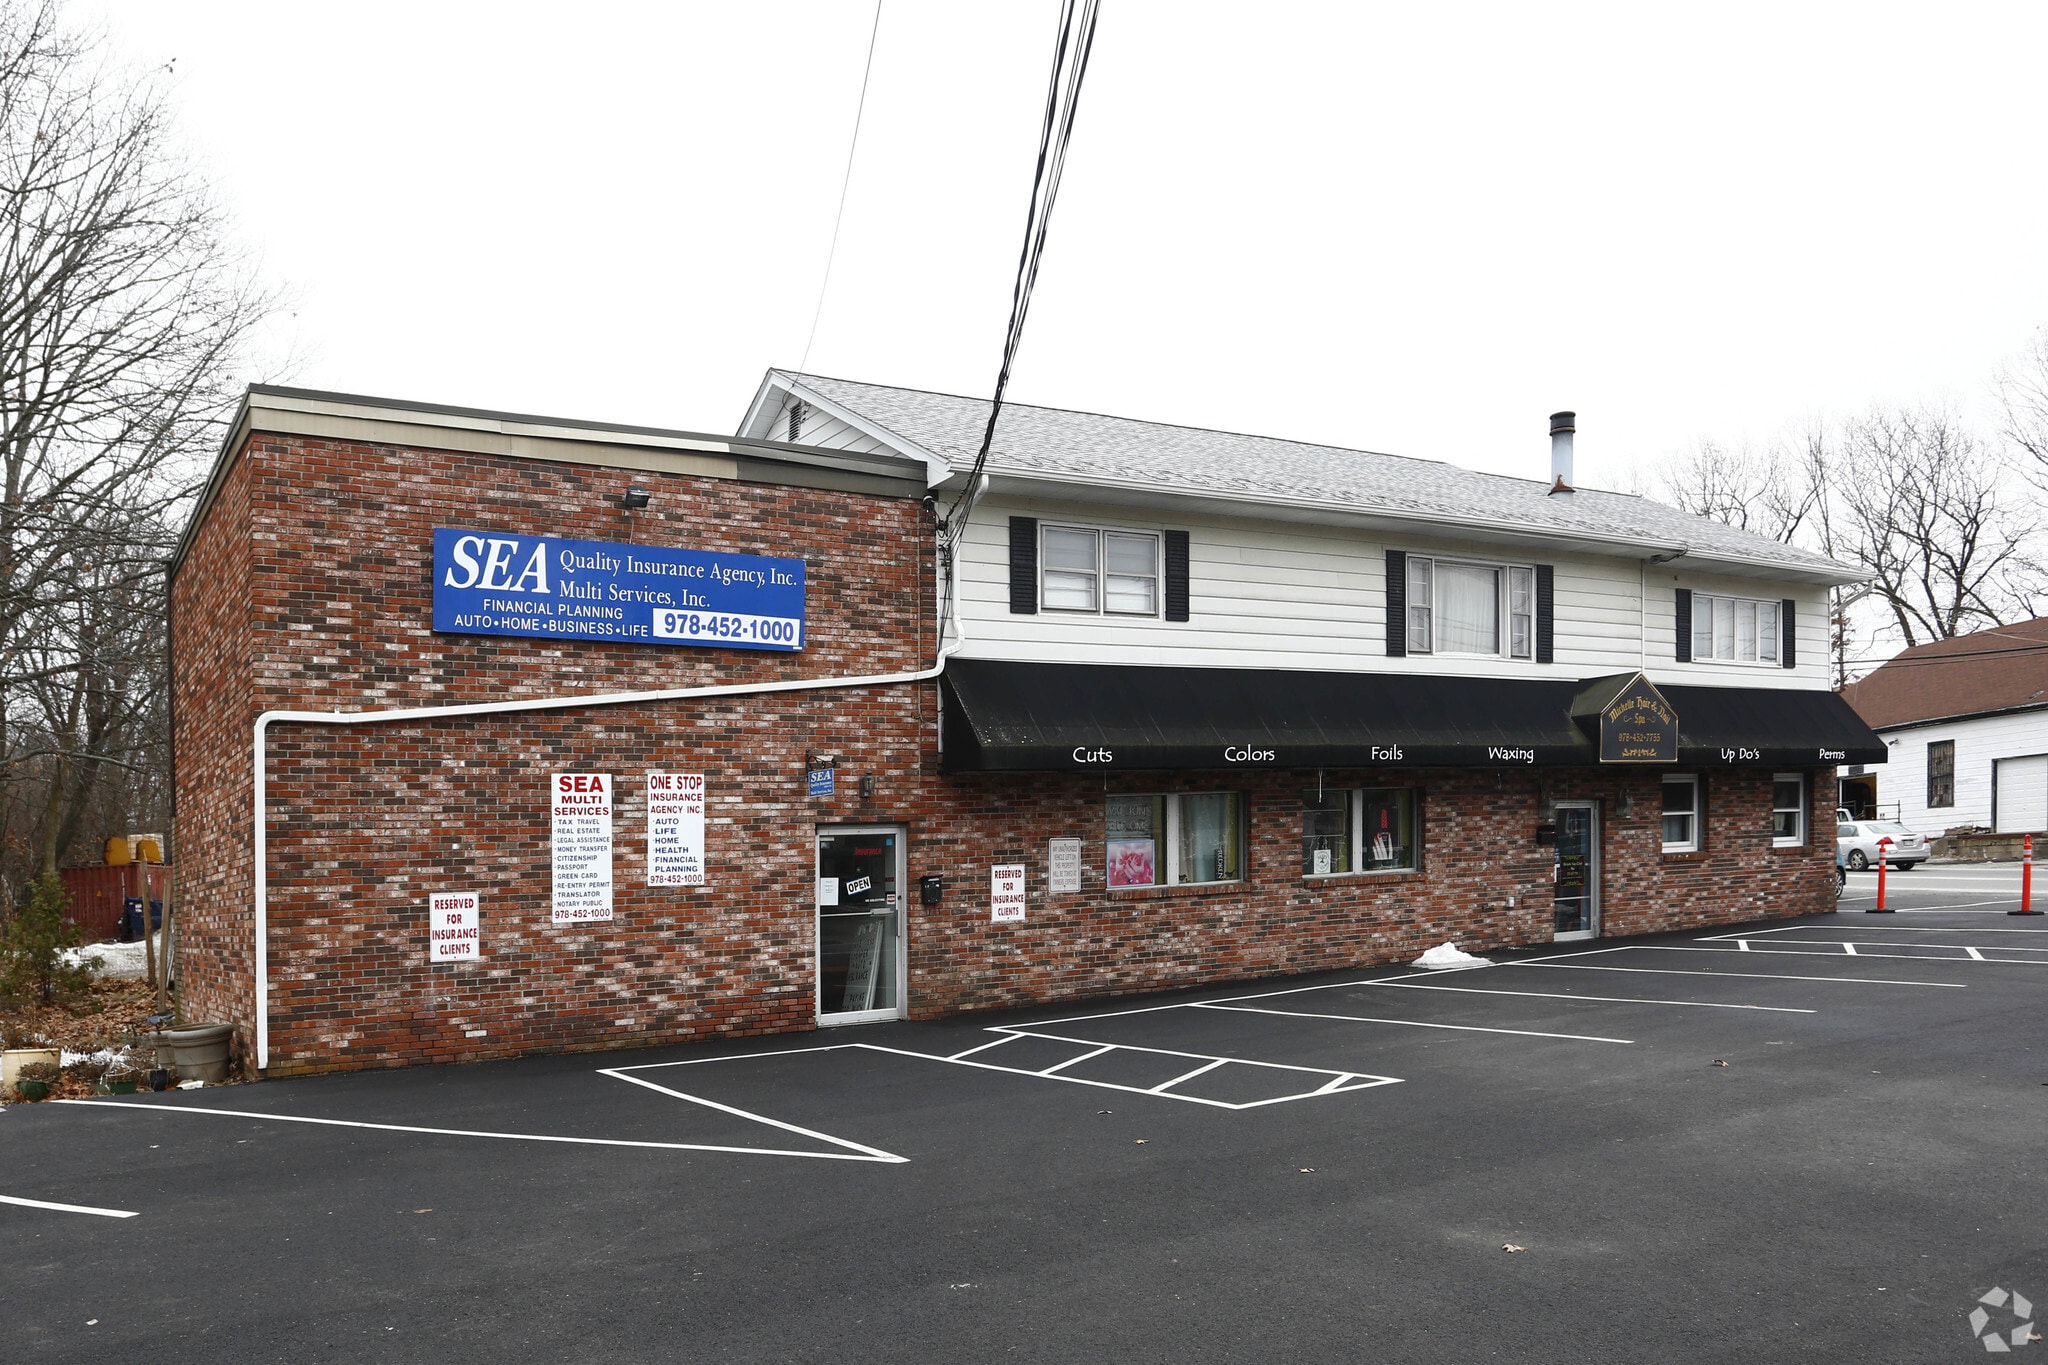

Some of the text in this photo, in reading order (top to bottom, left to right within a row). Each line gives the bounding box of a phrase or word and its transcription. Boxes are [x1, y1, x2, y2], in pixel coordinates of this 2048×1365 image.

[444, 536, 551, 594] SEA
[560, 549, 797, 588] Quality Insurance Agency, Inc.
[559, 580, 710, 607] Multi Services, Inc.
[483, 599, 623, 620] FINANCIAL PLANNING
[664, 612, 794, 642] 978-452-1000
[1609, 696, 1671, 725] Michelle Hair & Nail
[1634, 712, 1646, 725] Spa
[1072, 747, 1113, 763] Cuts
[1224, 744, 1275, 762] Colors
[1371, 746, 1403, 761] Foils
[1488, 747, 1534, 764] Waxing
[1721, 748, 1760, 763] Up Do's
[1819, 748, 1845, 760] Perms
[650, 775, 703, 790] ONE STOP
[811, 770, 832, 783] SEA
[559, 775, 604, 793] SEA
[561, 795, 602, 804] MULTI
[650, 793, 703, 801] INSURANCE
[554, 807, 610, 816] SERVICES
[650, 805, 703, 814] AGENCY INC.
[655, 827, 677, 835] LIFE
[655, 865, 698, 873] PLANNING
[994, 869, 1022, 879] RESERVED
[650, 874, 703, 883] 978-452-1000
[848, 878, 870, 893] OPEN
[1003, 882, 1014, 891] FOR
[435, 898, 474, 910] RESERVED
[992, 894, 1024, 904] INSURANCE
[555, 908, 610, 919] 978-452-1000
[997, 907, 1019, 916] CLIENTS
[447, 913, 462, 924] FOR
[432, 928, 477, 940] INSURANCE
[440, 943, 471, 955] CLIENTS
